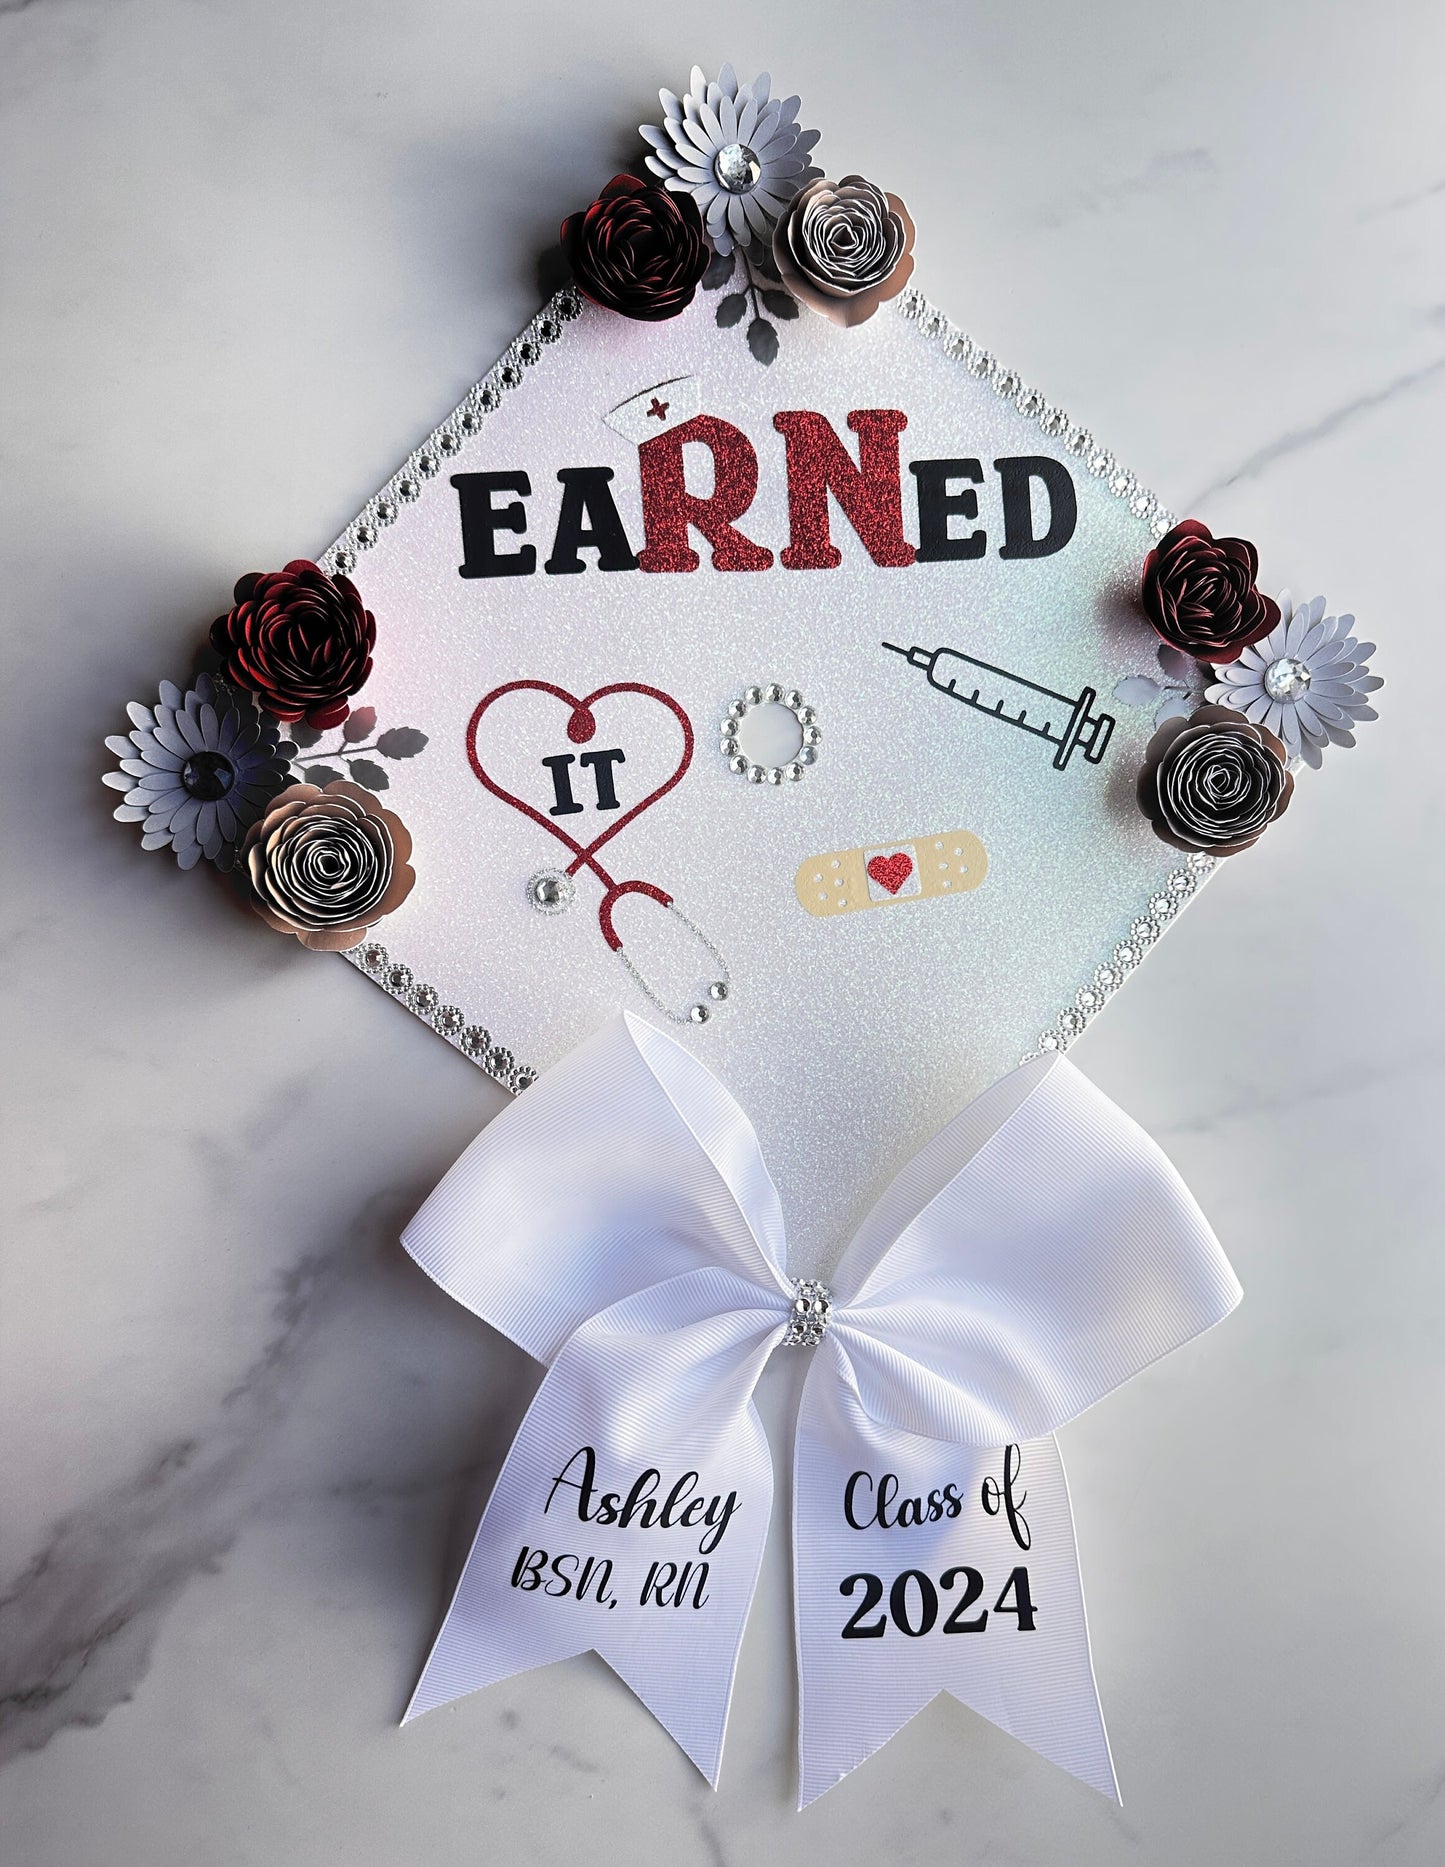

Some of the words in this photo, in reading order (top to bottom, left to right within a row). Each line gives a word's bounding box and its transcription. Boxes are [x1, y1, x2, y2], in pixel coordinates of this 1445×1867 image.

[450, 409, 1077, 579] EARNED
[542, 748, 625, 815] IT
[544, 1446, 742, 1554] Ashley
[844, 1470, 963, 1530] Class
[981, 1443, 1031, 1551] of
[511, 1546, 617, 1609] BSN,
[640, 1561, 710, 1609] RN
[839, 1566, 1038, 1639] 2024
